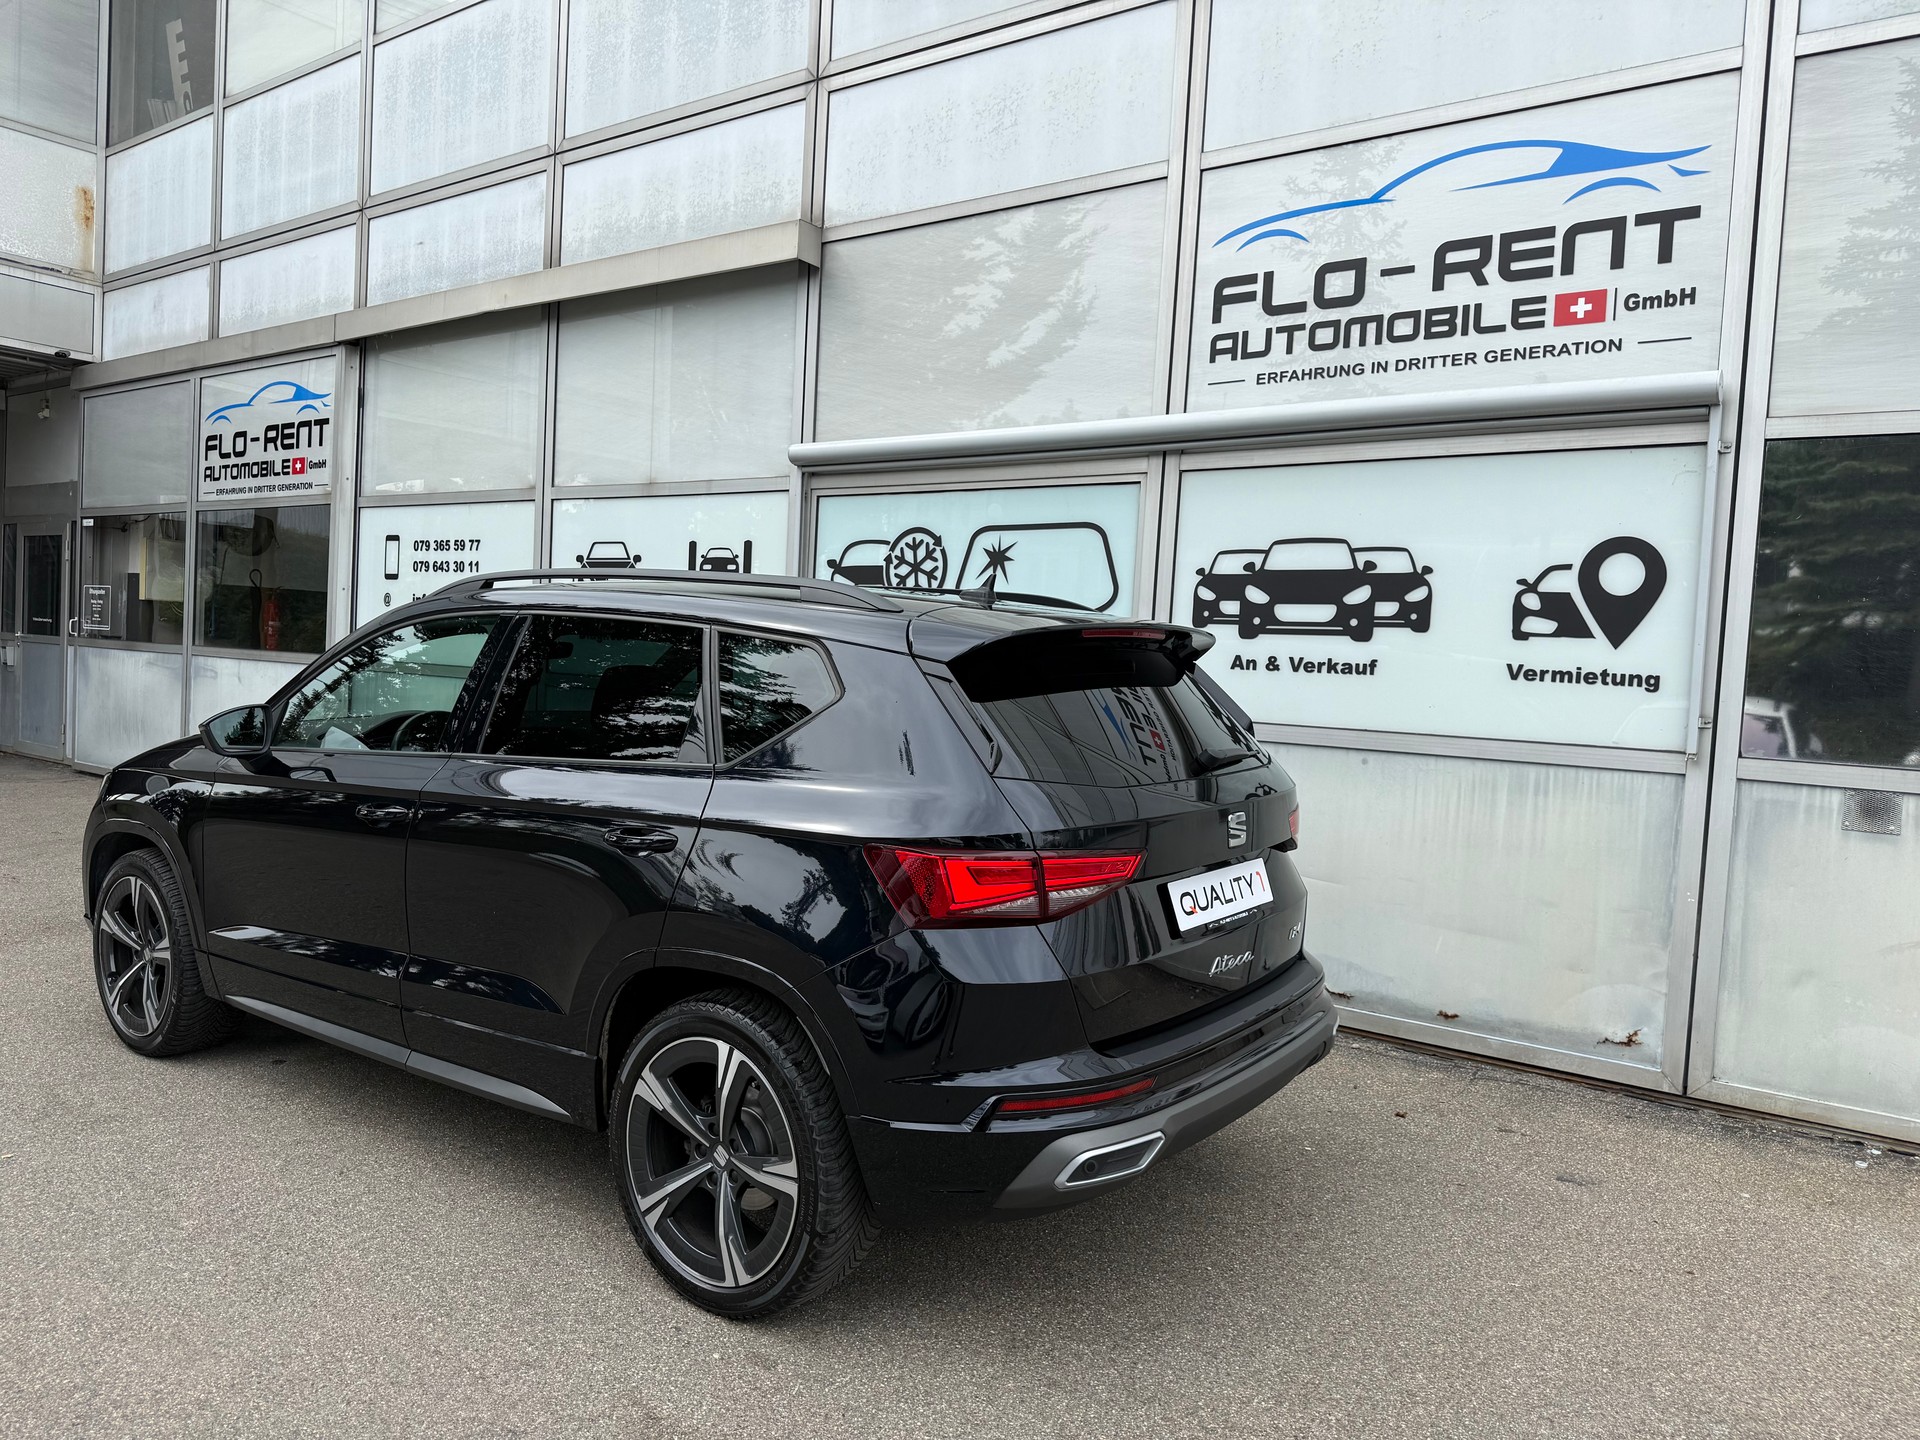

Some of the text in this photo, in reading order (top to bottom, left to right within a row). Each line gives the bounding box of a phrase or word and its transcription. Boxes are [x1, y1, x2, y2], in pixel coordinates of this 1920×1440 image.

[1208, 286, 1698, 364] AUTOMOBILE GmbH
[1255, 338, 1624, 386] ERFAHRUNG IN DRITTER GENERATION
[203, 458, 327, 482] AUTOMOBILE GmbH
[215, 482, 314, 496] ERFAHRUNG IN DRITTER GENERATION
[413, 539, 481, 551] 079 365 59 77
[412, 561, 480, 573] 079 643 30 11
[1229, 654, 1379, 677] An & Verkauf
[1506, 663, 1662, 693] Vermietung
[1208, 951, 1255, 978] Ateca
